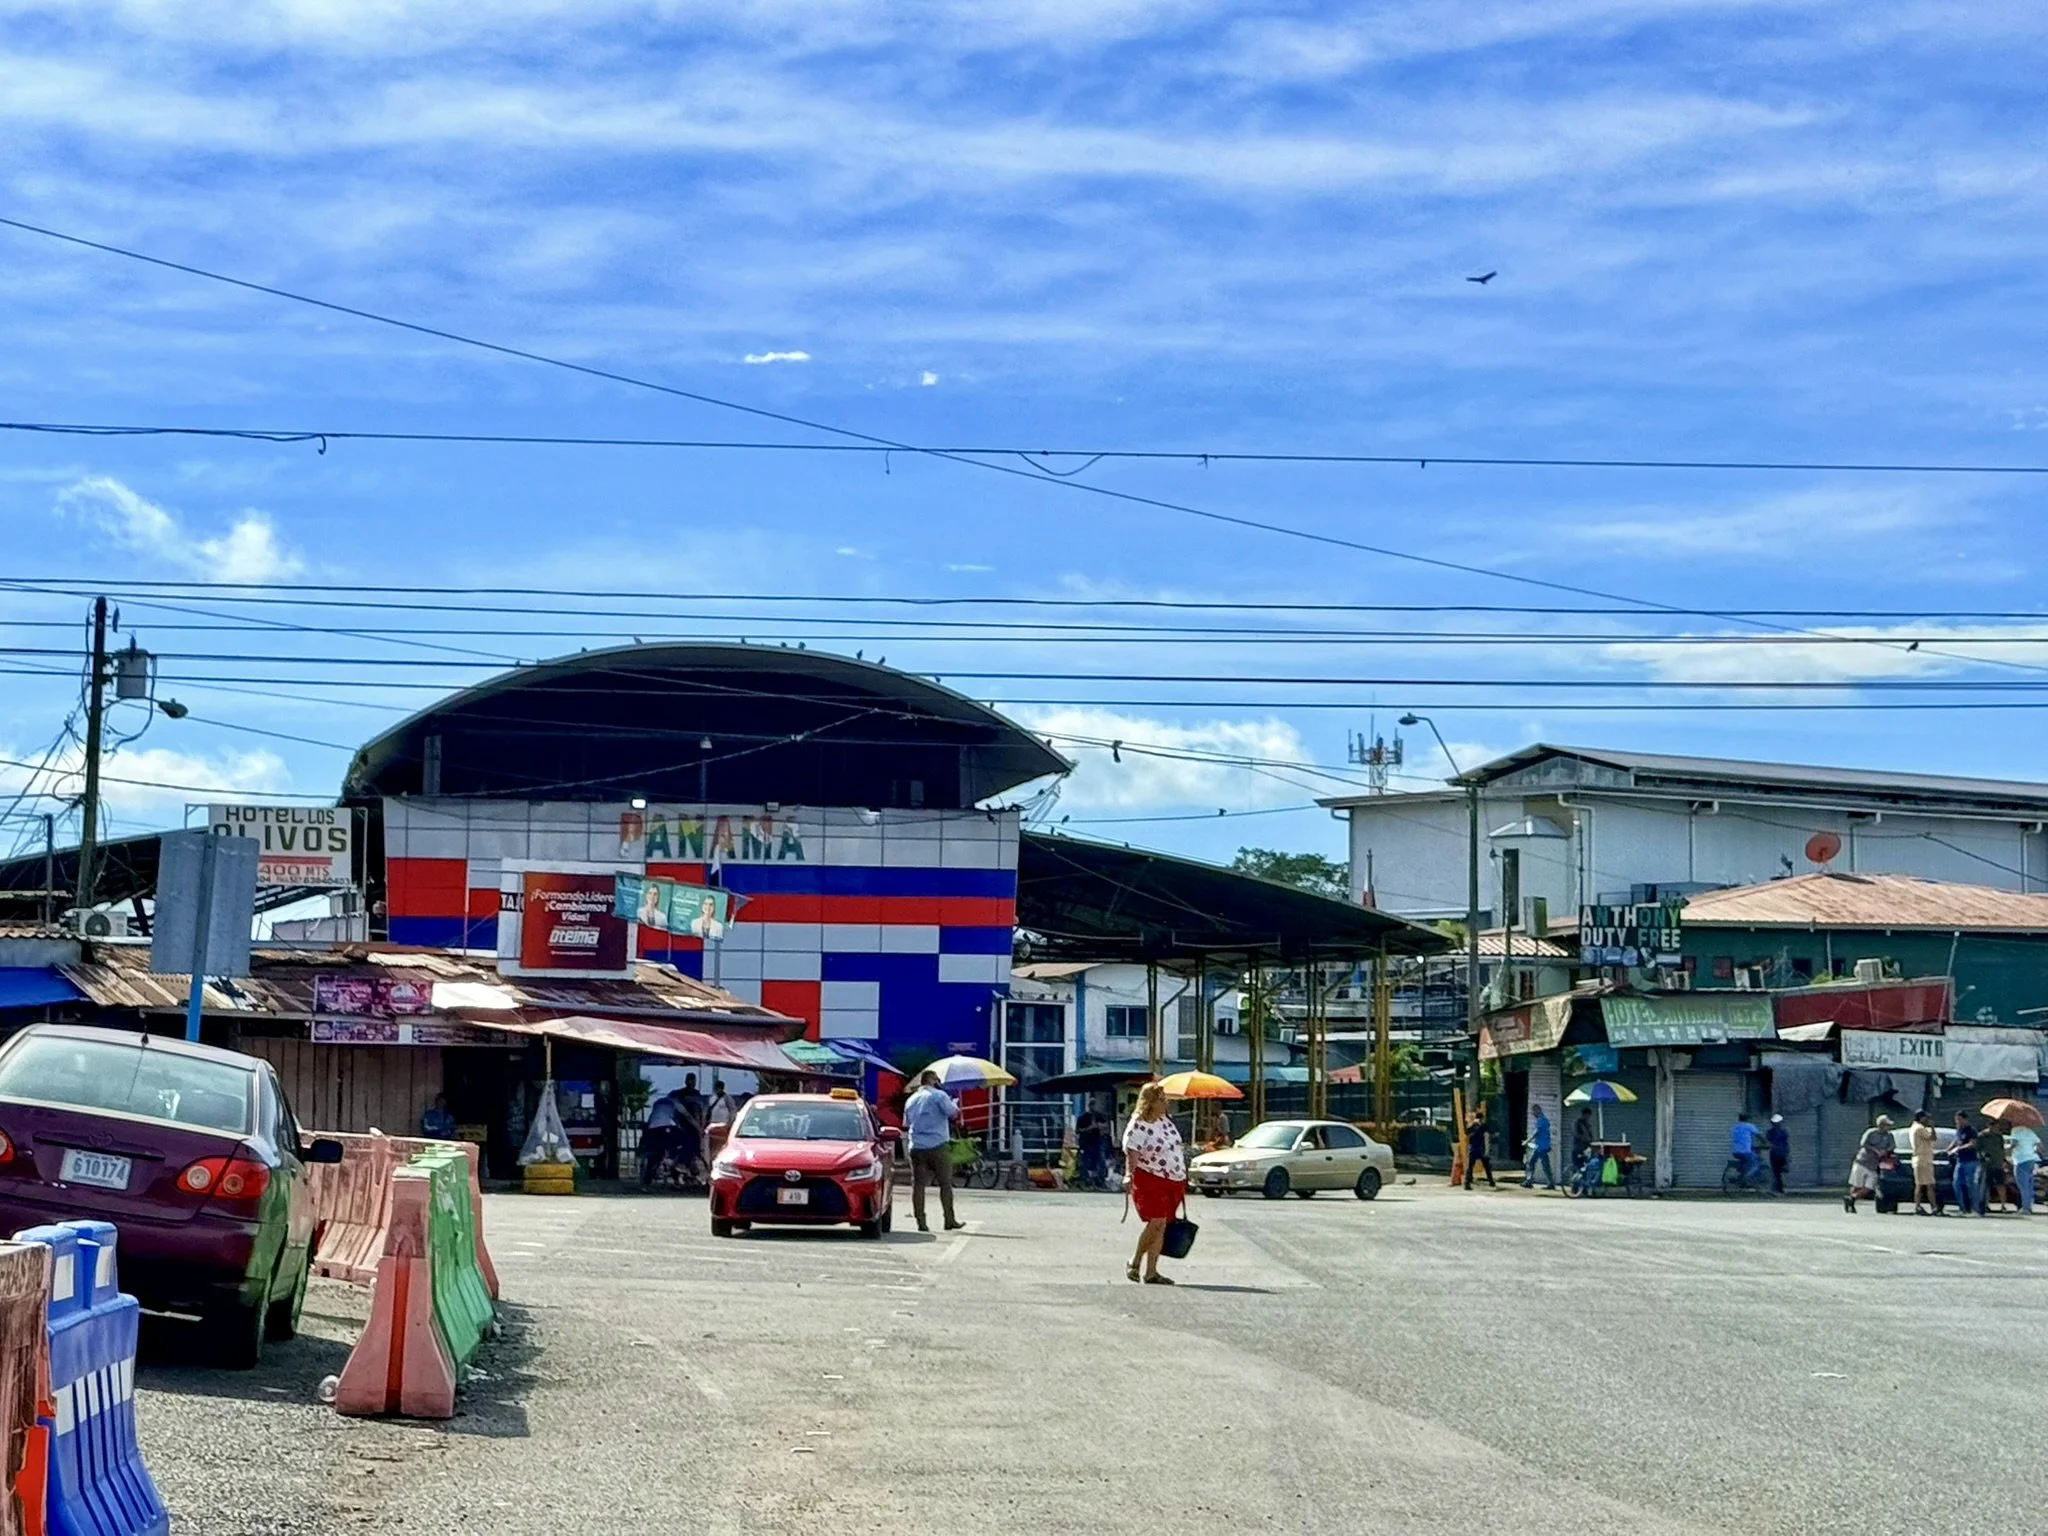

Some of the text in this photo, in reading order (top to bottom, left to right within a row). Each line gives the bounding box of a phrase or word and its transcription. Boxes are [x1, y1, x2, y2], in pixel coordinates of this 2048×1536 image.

[308, 809, 335, 825] LOS
[305, 865, 330, 877] MTS
[1581, 906, 1680, 928] ANTHONY
[1580, 927, 1681, 948] DUTY FREE
